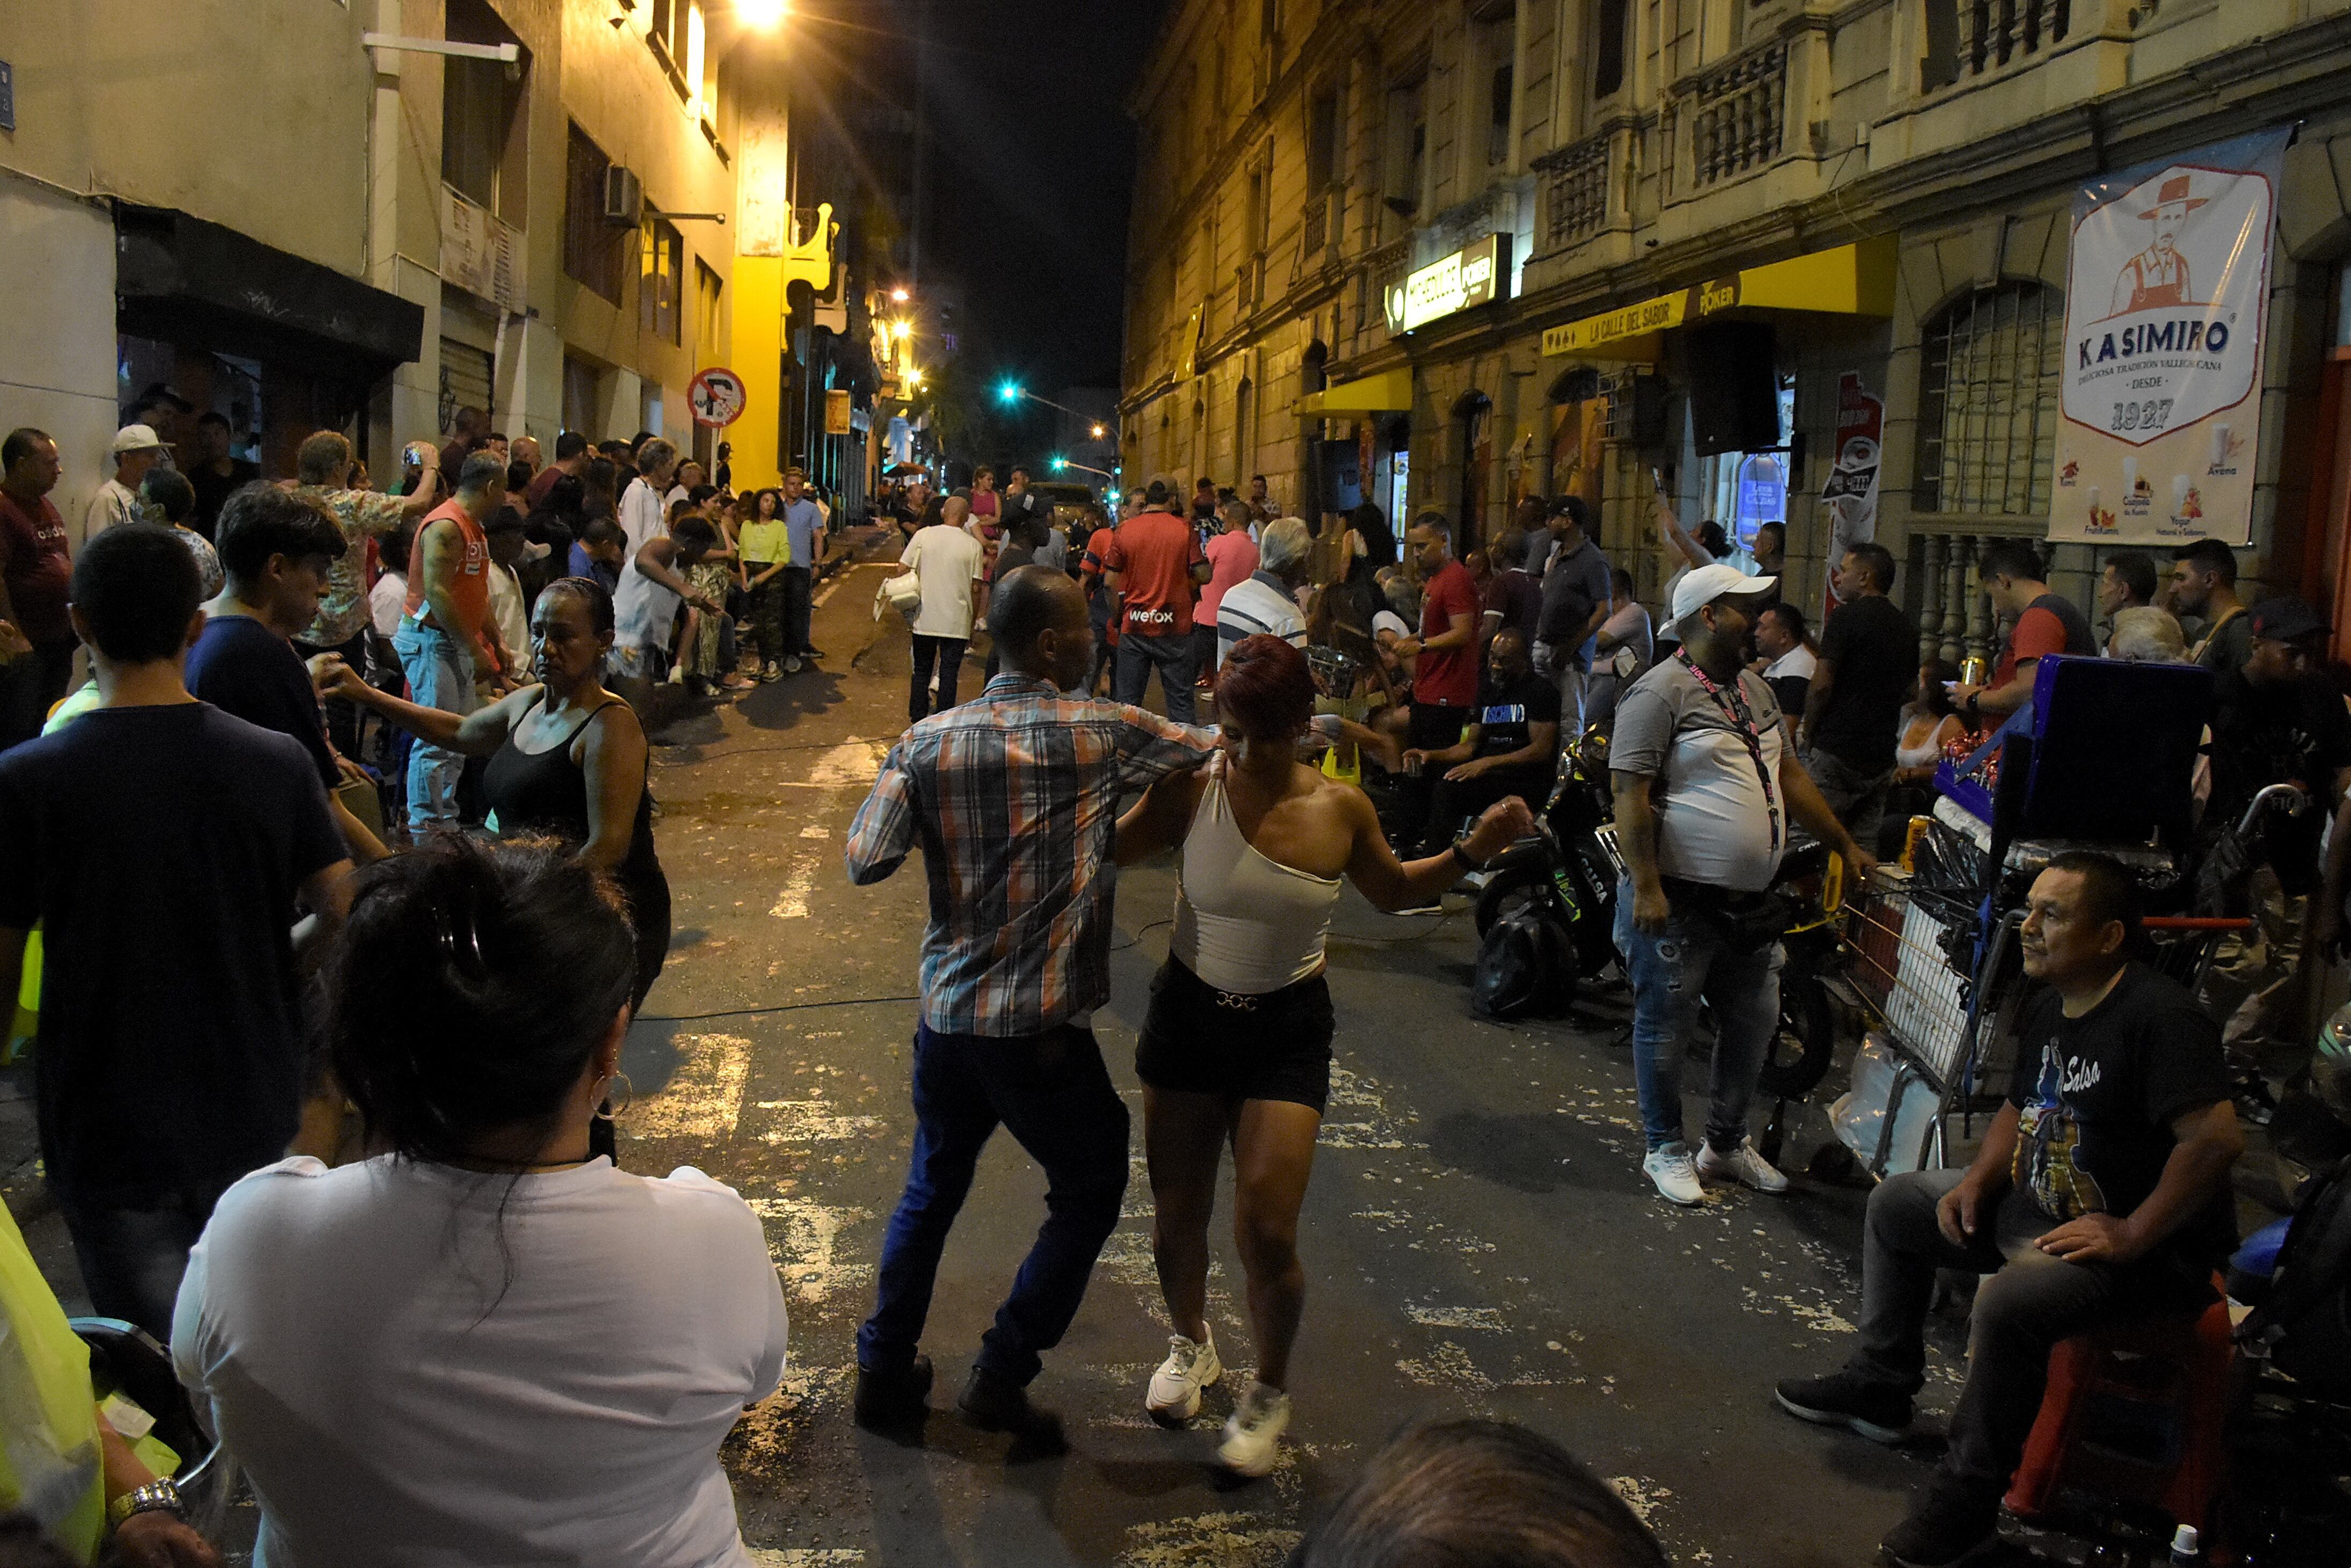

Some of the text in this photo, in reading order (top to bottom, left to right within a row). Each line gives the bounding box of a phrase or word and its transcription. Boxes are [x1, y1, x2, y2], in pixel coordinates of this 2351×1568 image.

[1700, 286, 1733, 316] POKER
[1590, 302, 1670, 343] LA CALLE DEL SABOR
[2079, 321, 2229, 371] KASIMIRO
[2131, 376, 2163, 389] DESDE
[2111, 398, 2174, 431] 1927
[1129, 608, 1173, 623] wefox
[2063, 1055, 2101, 1092] Salsa
